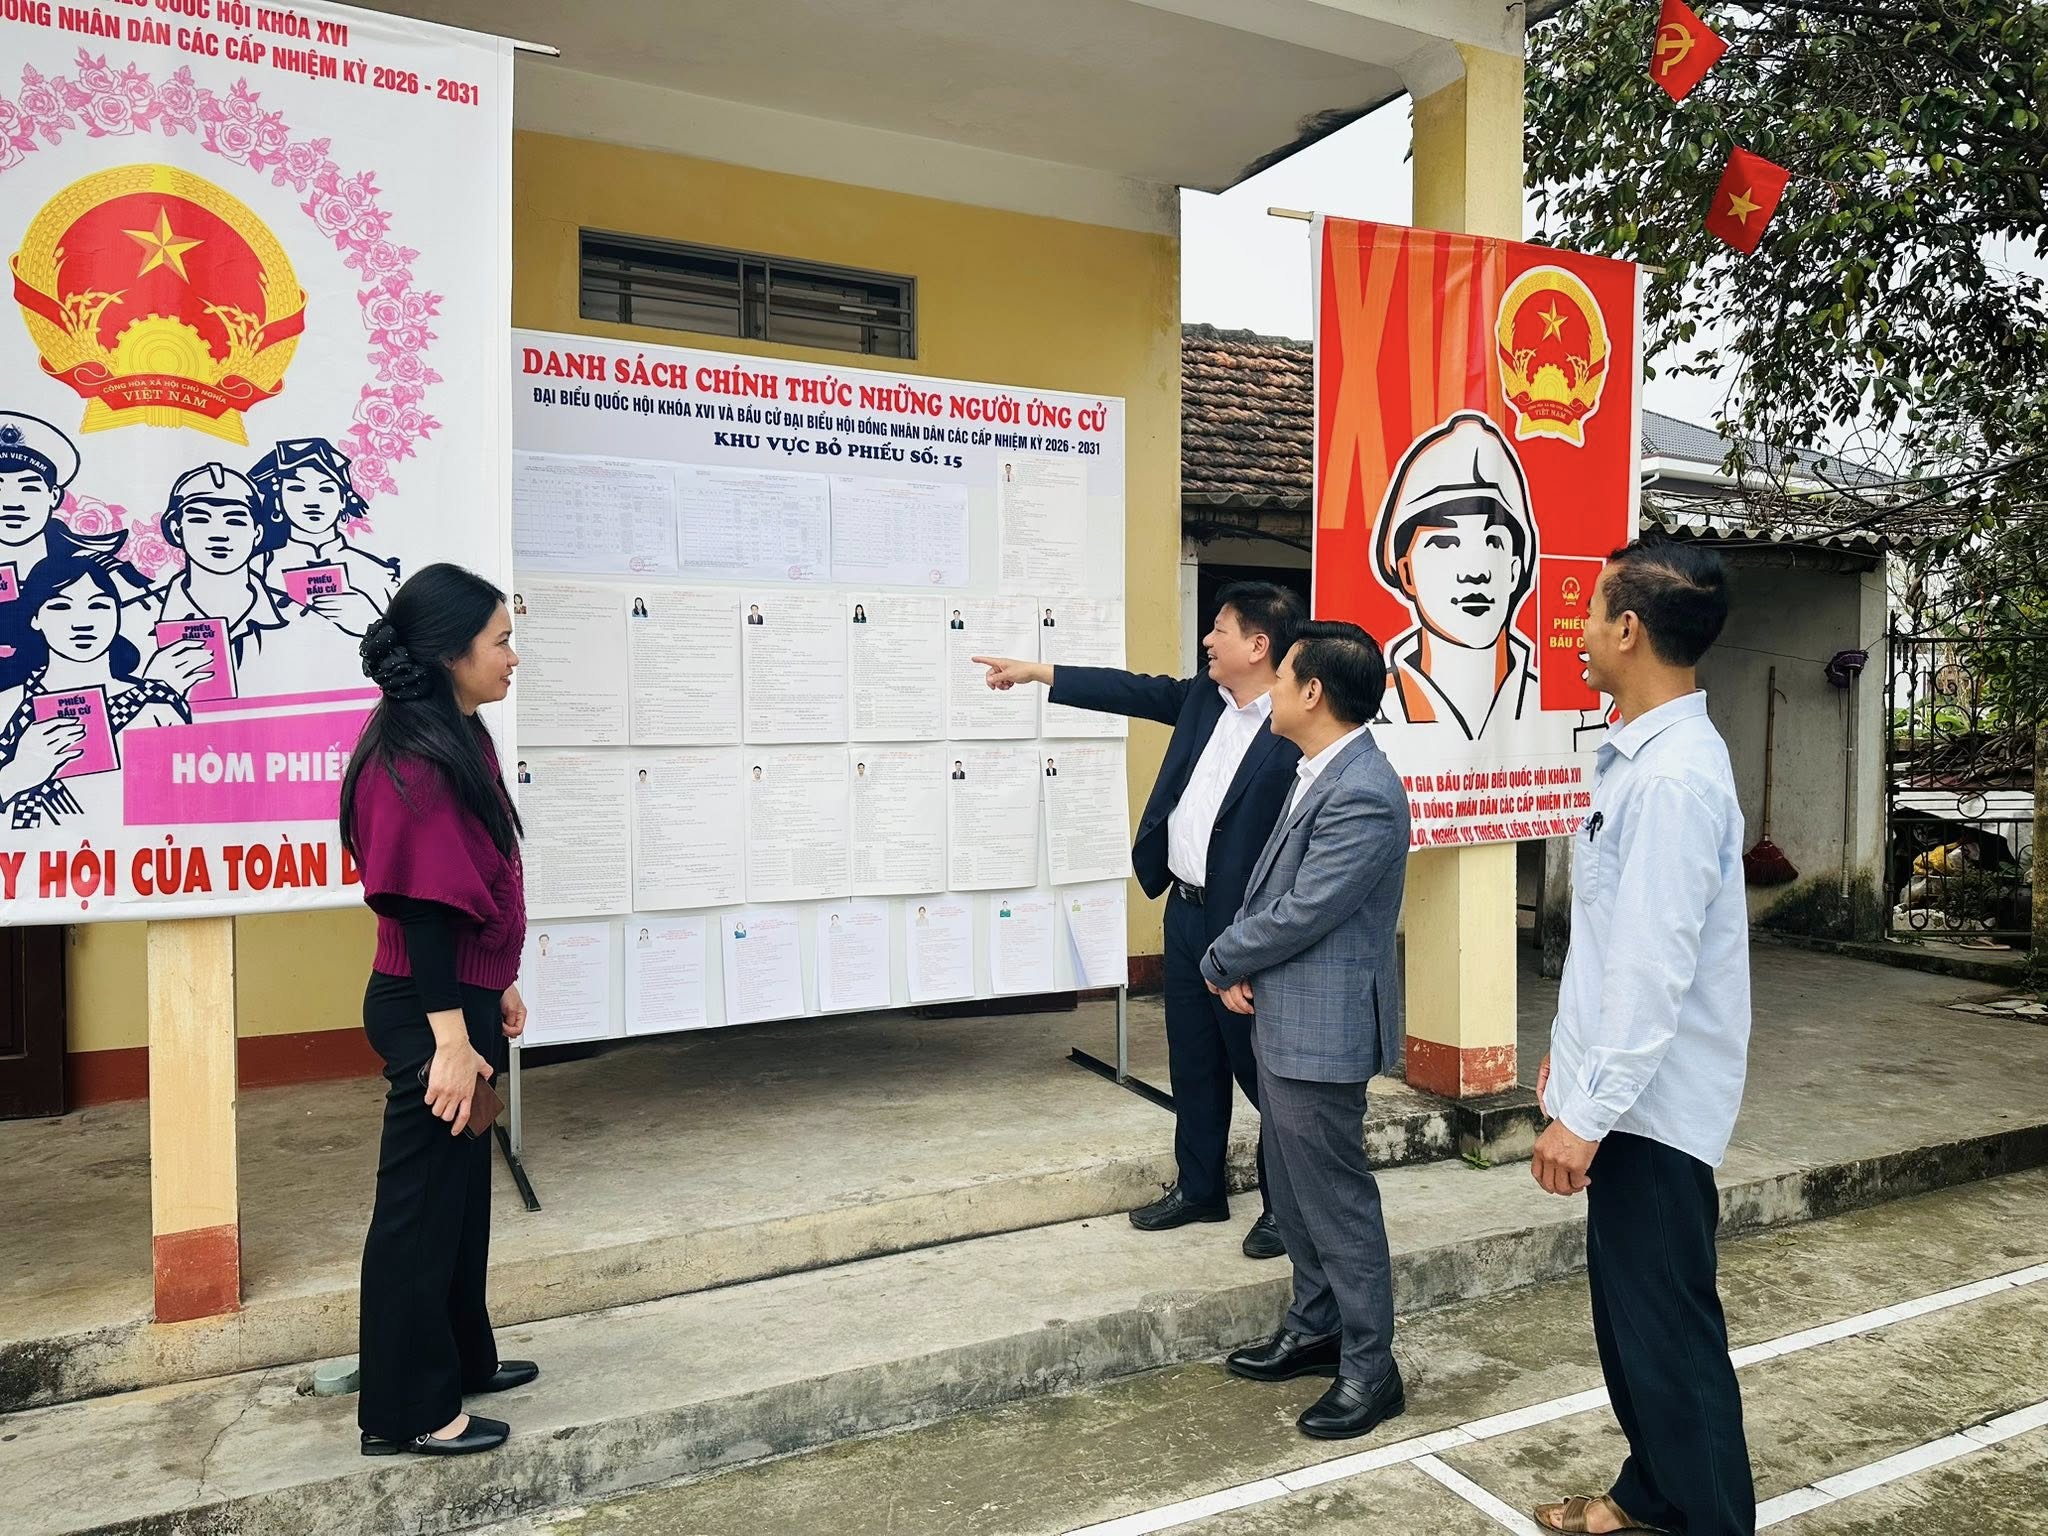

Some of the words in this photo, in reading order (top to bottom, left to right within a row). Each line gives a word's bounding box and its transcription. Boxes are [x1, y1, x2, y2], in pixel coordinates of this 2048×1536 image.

[217, 0, 251, 30] HỘI
[258, 9, 311, 40] KHÓA
[317, 20, 348, 47] XVI
[0, 0, 51, 27] ỒNG
[58, 6, 120, 39] NHÂN
[128, 17, 171, 46] DÂN
[178, 27, 219, 56] CÁC
[226, 33, 266, 64] CẤP
[273, 46, 337, 80] NHIỆM
[343, 58, 368, 85] KỲ
[373, 66, 419, 95] 2026
[437, 79, 478, 106] 2031
[123, 387, 163, 402] VIỆT
[168, 390, 208, 409] NAM
[522, 348, 606, 381] DANH
[614, 353, 688, 389] SÁCH
[695, 365, 778, 399] CHÍNH
[785, 375, 852, 407] THỨC
[859, 384, 943, 416] NHỮNG
[949, 394, 1020, 424] NGƯỜI
[1026, 398, 1072, 429] ỨNG
[1078, 401, 1107, 432] CỬ
[533, 387, 556, 407] ĐẠI
[560, 386, 590, 407] BIỂU
[594, 390, 629, 411] QUỐC
[633, 395, 654, 416] HỘI
[658, 398, 692, 417] KHÓA
[695, 403, 715, 419] XVI
[718, 404, 734, 421] VÀ
[737, 404, 761, 424] BẦU
[765, 406, 782, 426] CỬ
[784, 412, 804, 431] ĐẠI
[807, 410, 833, 431] BIỂU
[836, 415, 855, 436] HỘI
[858, 416, 887, 436] ĐỒNG
[890, 421, 920, 440] NHÂN
[923, 425, 945, 442] DÂN
[948, 427, 969, 444] CÁC
[971, 427, 992, 446] CẤP
[994, 432, 1028, 451] NHIỆM
[1031, 433, 1043, 450] KỲ
[1045, 438, 1069, 453] 2026
[1078, 441, 1101, 455] 2031
[714, 431, 760, 448] KHU
[766, 436, 810, 455] VỰC
[815, 437, 842, 456] BỎ
[847, 441, 904, 461] PHIẾU
[910, 446, 939, 465] SỐ:
[944, 455, 963, 469] 15
[307, 574, 333, 585] PHIẾU
[1549, 633, 1573, 648] BẦU
[1577, 637, 1585, 648] C
[172, 745, 255, 784] HÒM
[1415, 775, 1434, 792] GIA
[1436, 769, 1460, 792] BẦU
[1463, 767, 1475, 790] CỬ
[1475, 772, 1489, 793] ĐẠI
[1491, 765, 1507, 788] BIỂU
[1509, 765, 1532, 789] QUỐC
[1534, 766, 1546, 789] HỘI
[1570, 767, 1581, 783] XVI
[1409, 798, 1421, 822] ỘI
[1423, 796, 1453, 818] ĐỒNG
[1456, 796, 1477, 817] NHÂN
[1480, 795, 1498, 815] DÂN
[1500, 793, 1514, 814] CÁC
[1517, 790, 1534, 812] CẤP
[1536, 791, 1560, 813] NHIỆM
[1563, 789, 1572, 809] KỲ
[1573, 792, 1590, 808] 2026
[1431, 824, 1461, 844] NGHĨA
[1460, 826, 1474, 845] VỤ
[1473, 821, 1507, 841] THIÊNG
[1506, 818, 1532, 839] LIÊNG
[1531, 814, 1550, 836] CỦA
[1566, 814, 1584, 833] CÔN
[39, 839, 116, 911] HỘI
[131, 834, 213, 897] CỦA
[223, 834, 327, 891] TOÀN
